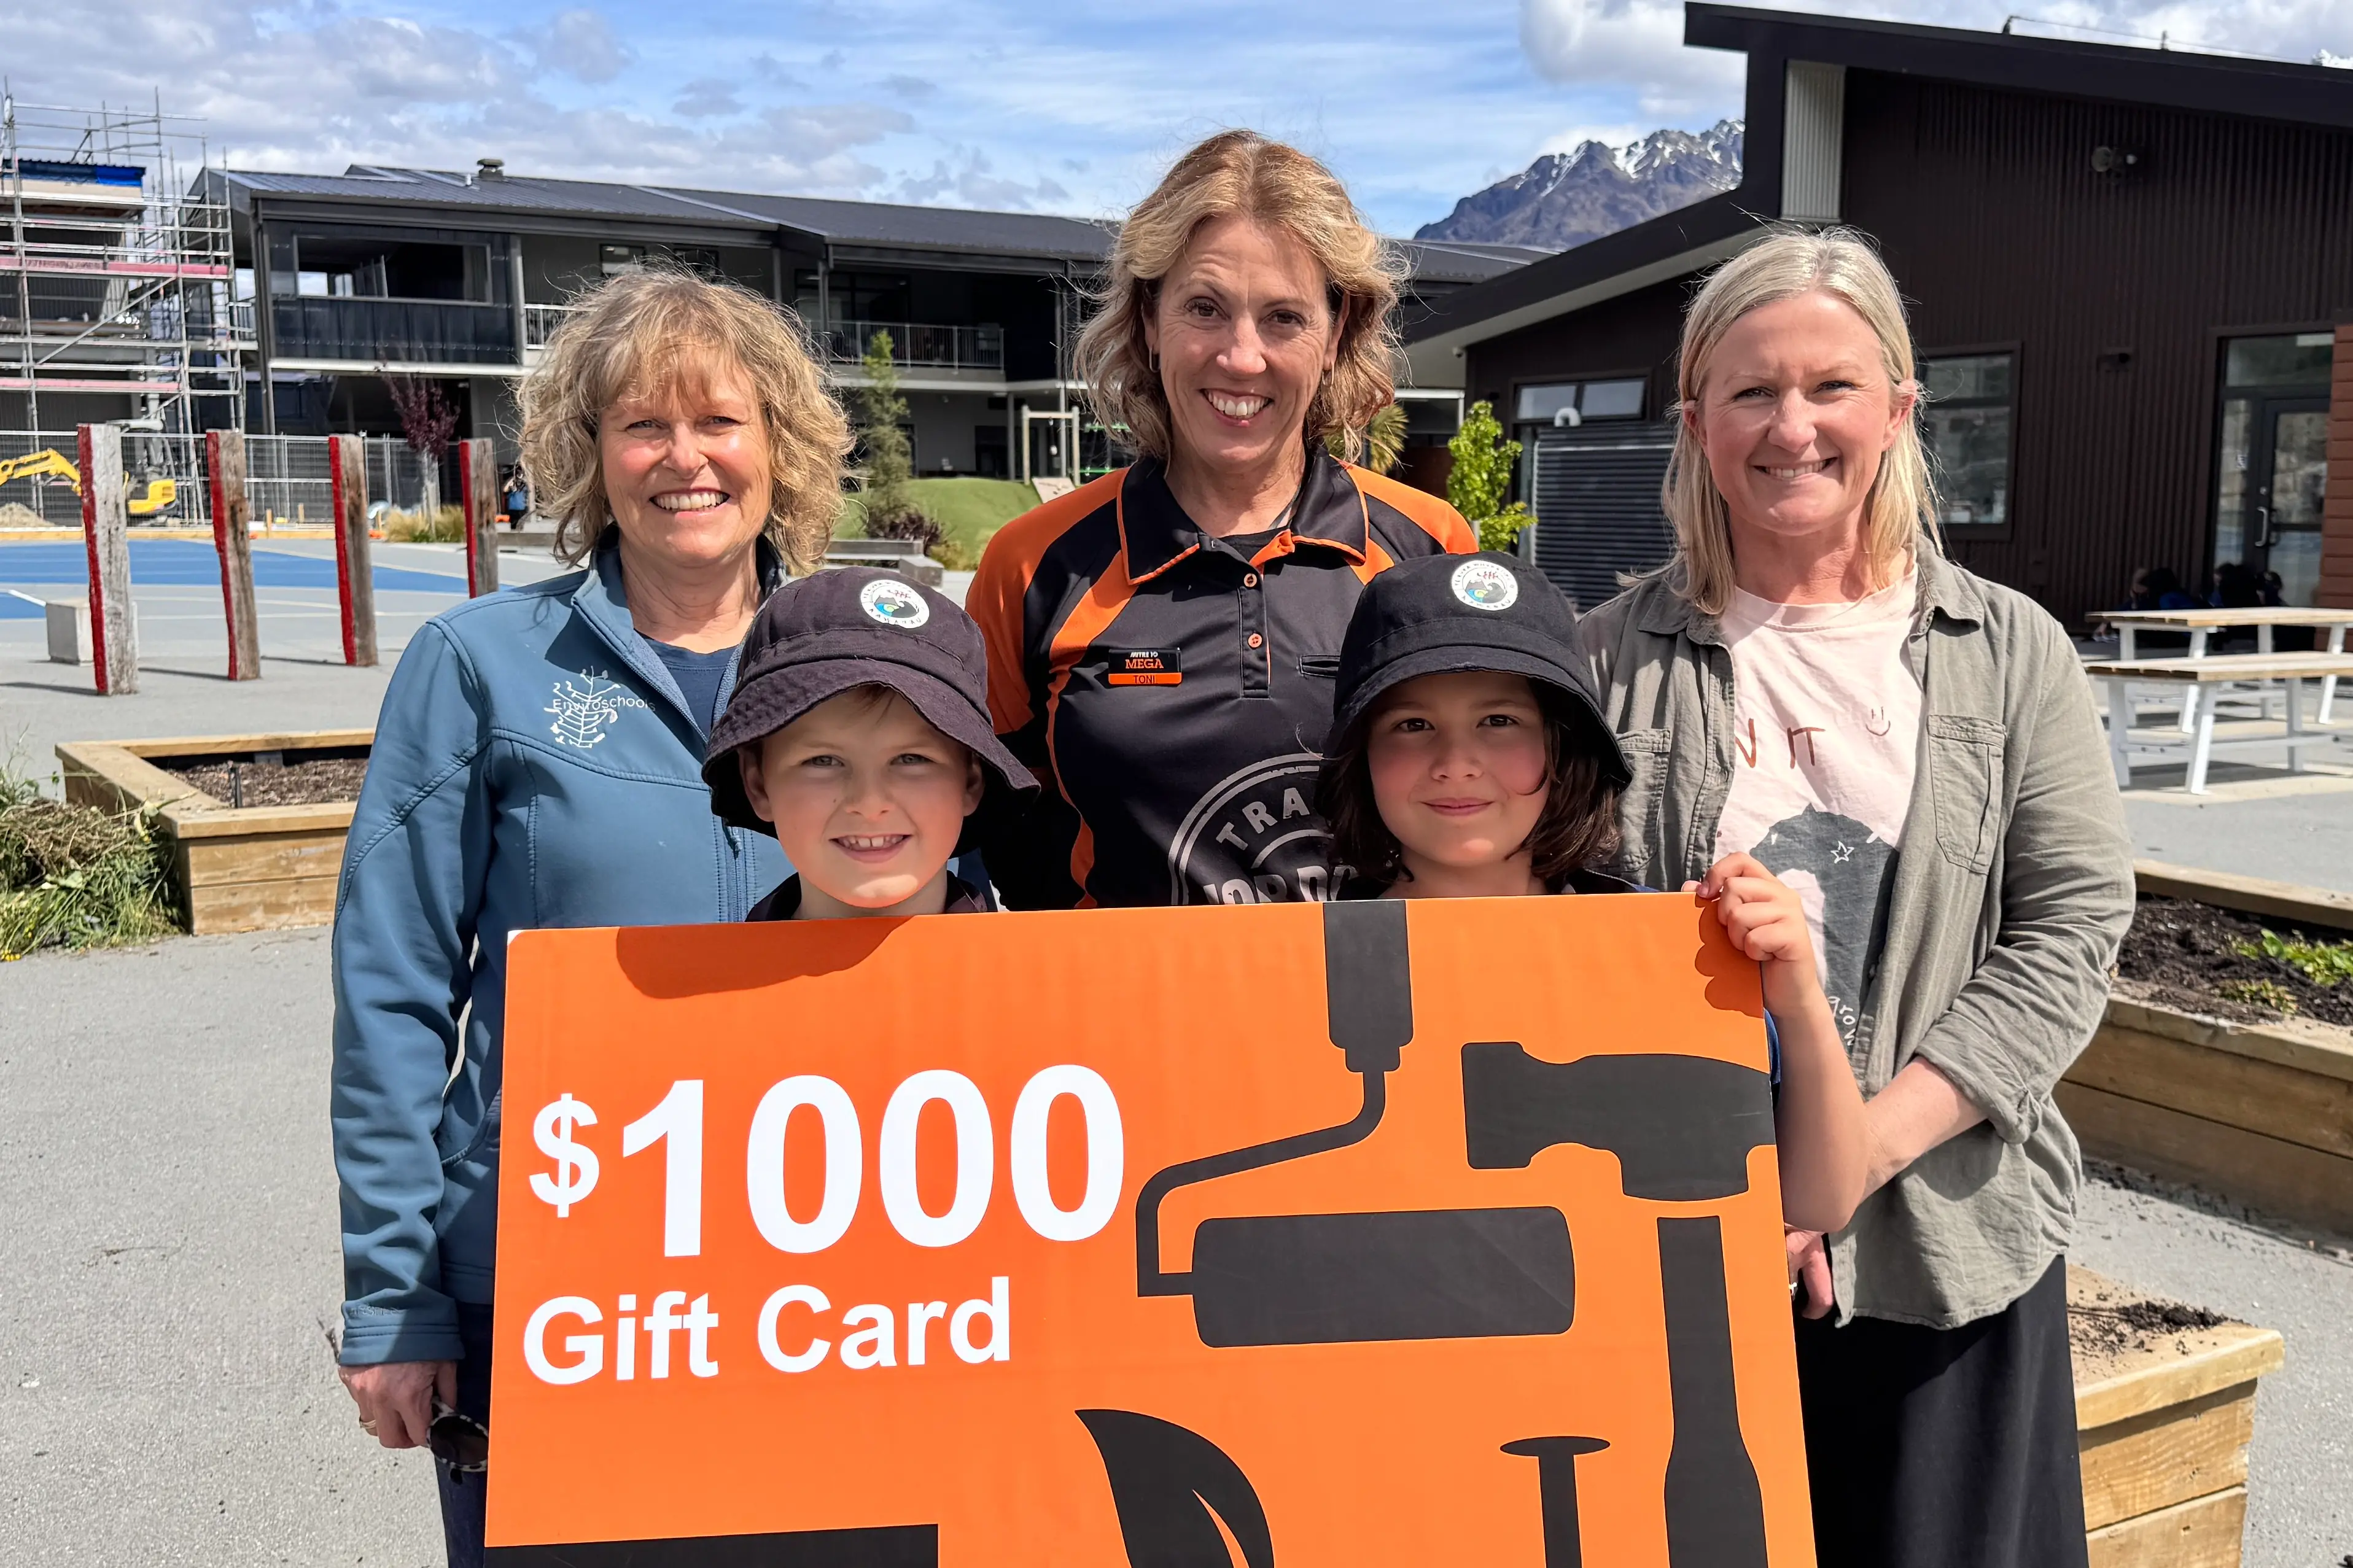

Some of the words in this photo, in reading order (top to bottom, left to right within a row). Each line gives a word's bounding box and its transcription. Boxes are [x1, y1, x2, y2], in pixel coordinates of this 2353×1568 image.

[1125, 659, 1164, 669] MEGA
[1134, 675, 1155, 684] TONI
[553, 694, 656, 712] Enviroschools
[529, 1064, 1124, 1257] $1000
[523, 1290, 719, 1385] Gift
[757, 1276, 1011, 1373] Card
